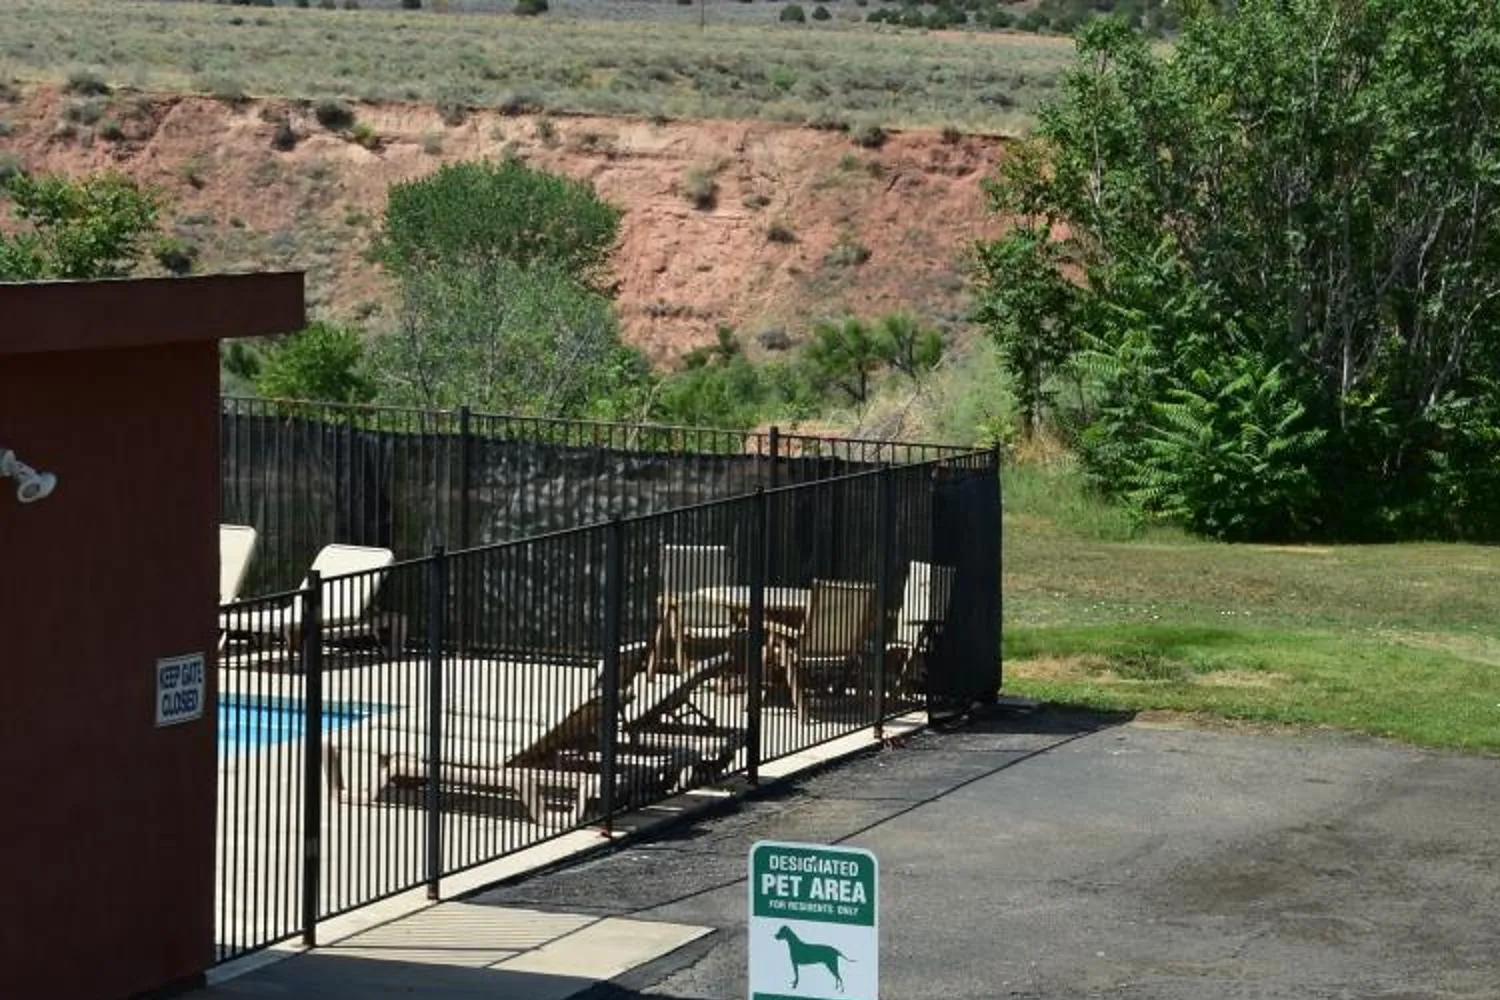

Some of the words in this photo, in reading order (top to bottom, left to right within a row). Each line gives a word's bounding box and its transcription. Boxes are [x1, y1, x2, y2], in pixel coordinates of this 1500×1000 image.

[160, 665, 180, 688] KEEP
[181, 661, 202, 686] GATE
[162, 689, 198, 716] CLOSED
[769, 855, 859, 876] DESIGNATED
[761, 874, 802, 897] PET
[810, 878, 867, 904] AREA
[768, 900, 786, 910] FOR
[787, 901, 834, 914] RESIDENTS
[837, 906, 859, 916] ONLY
